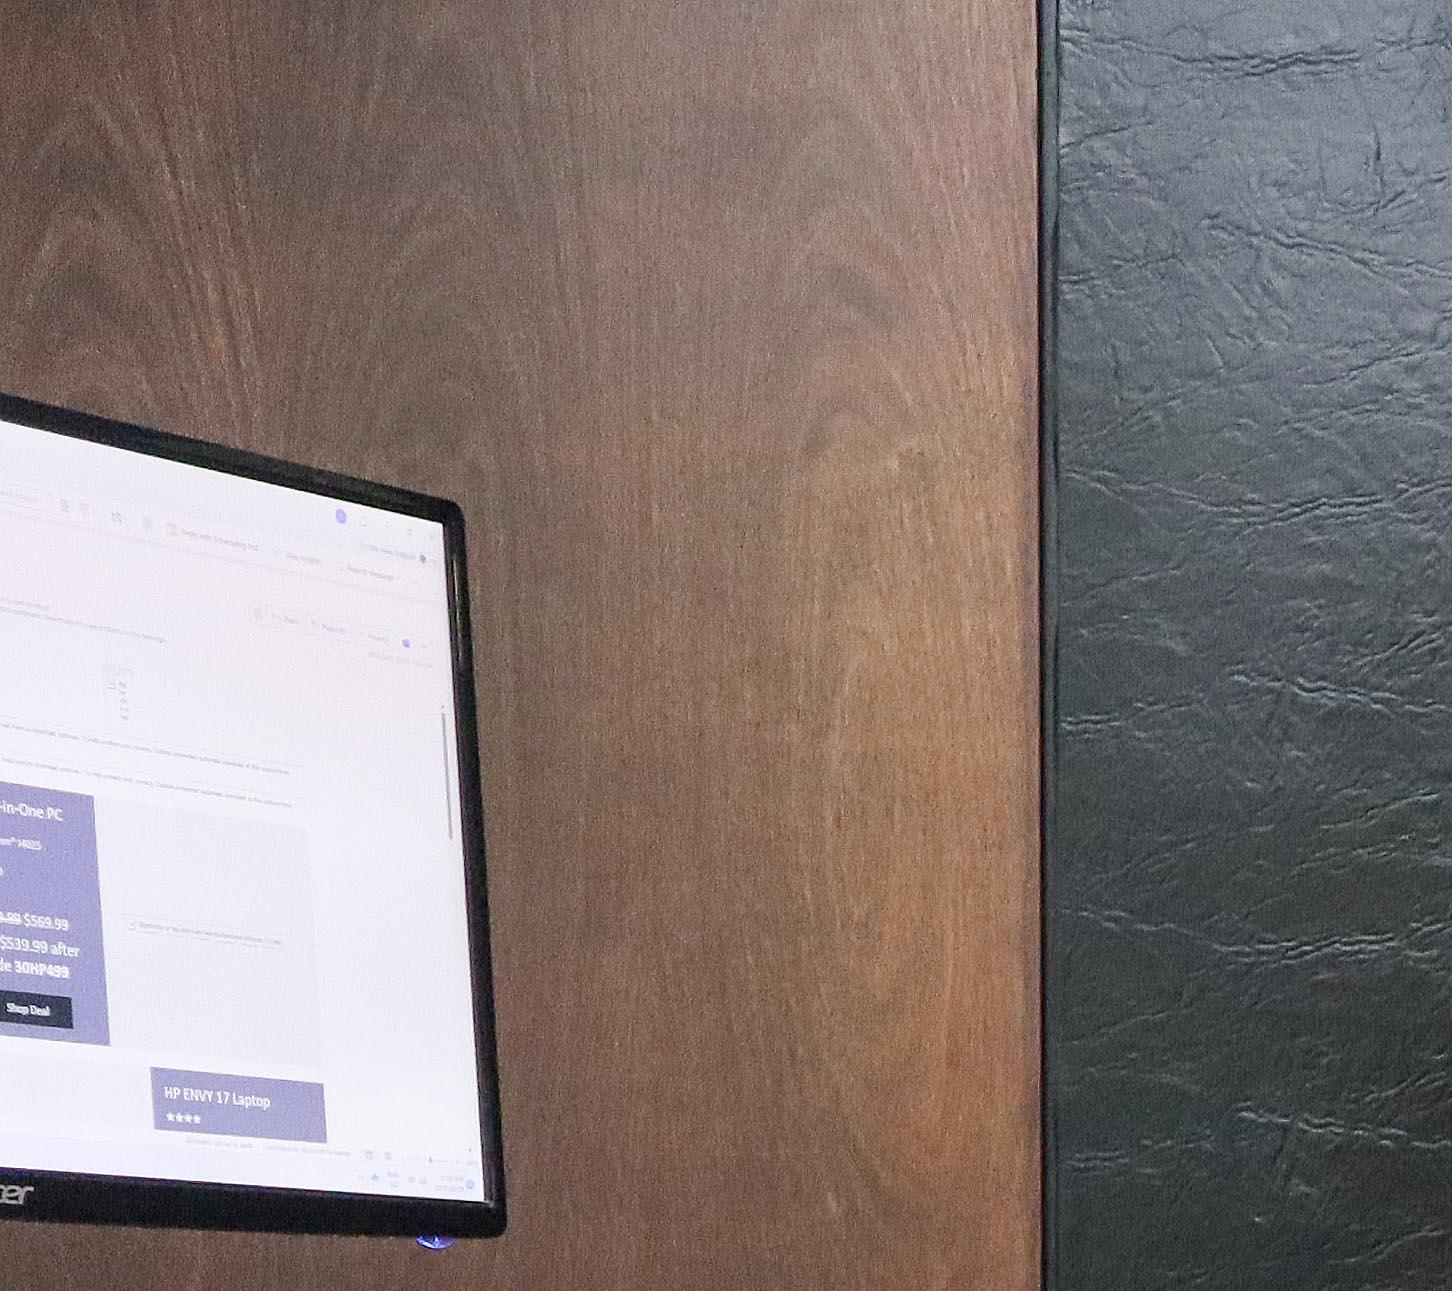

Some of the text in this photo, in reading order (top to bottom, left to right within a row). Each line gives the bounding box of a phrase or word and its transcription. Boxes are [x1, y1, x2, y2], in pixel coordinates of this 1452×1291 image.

[46, 807, 64, 822] PC
[49, 941, 80, 957] after
[164, 1086, 272, 1111] HP ENVY 17 Laptop
